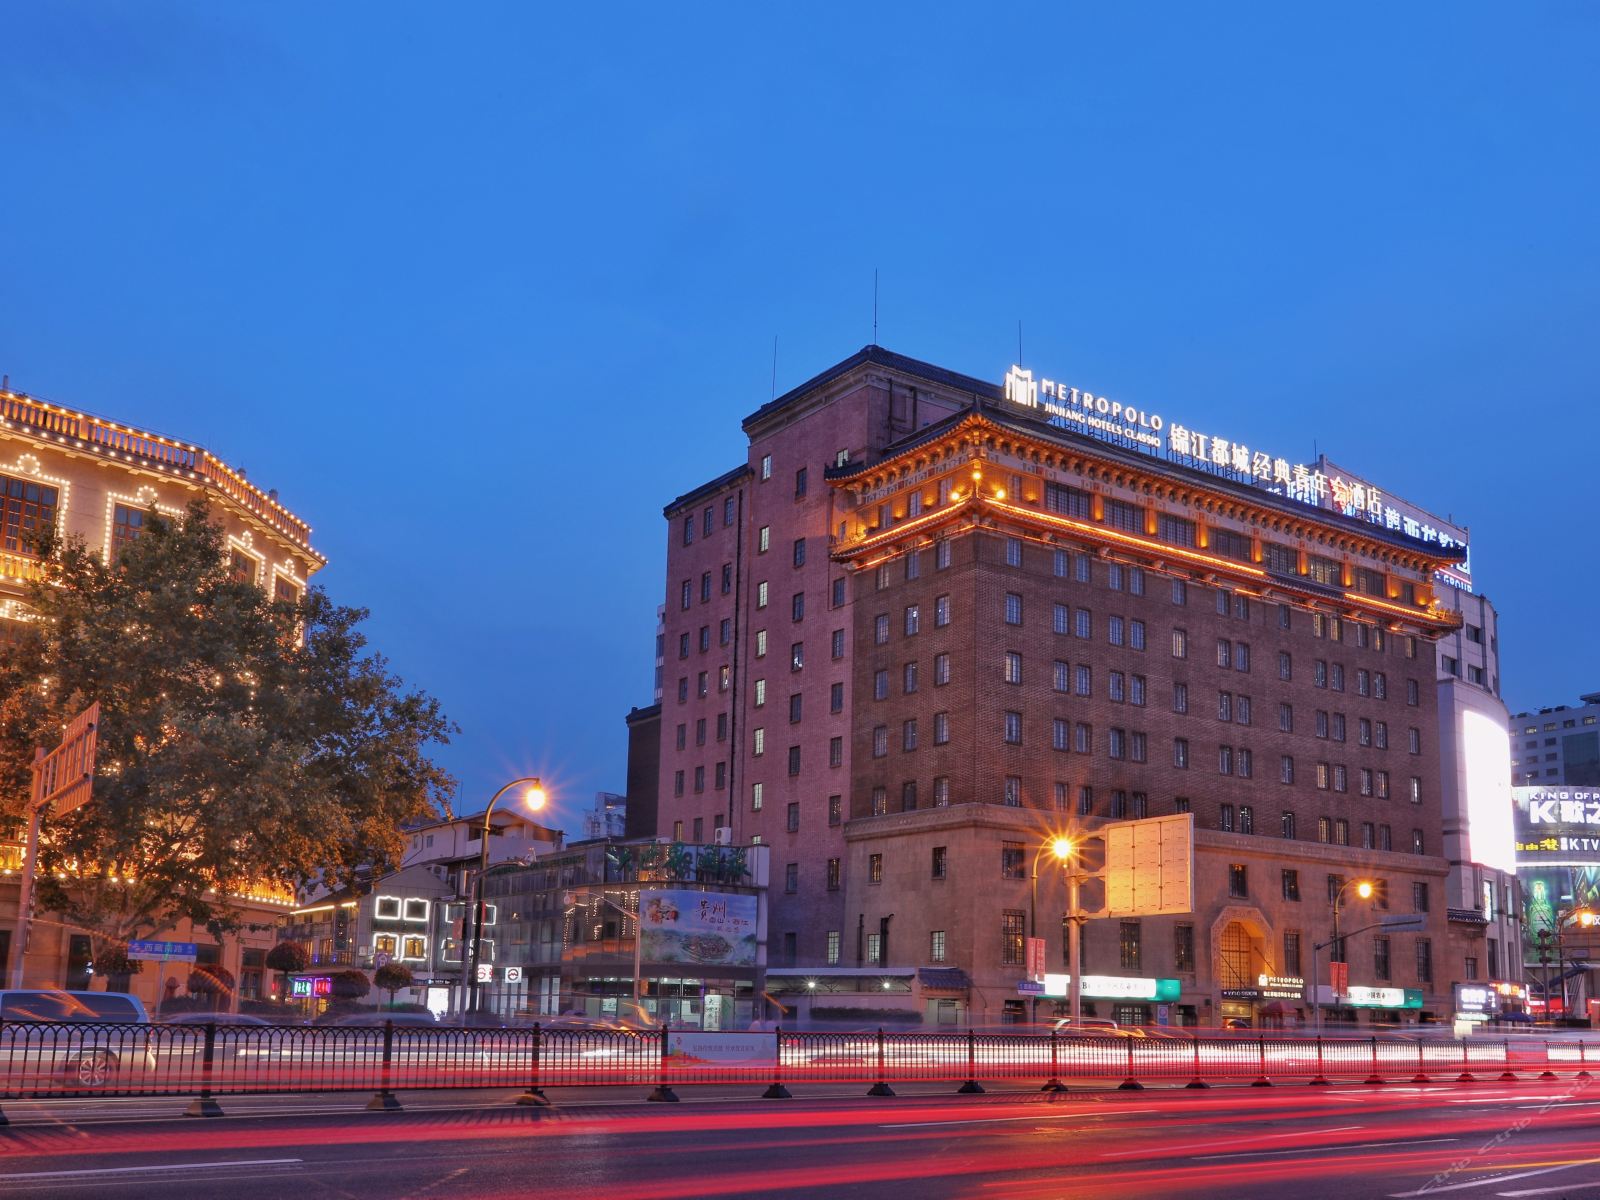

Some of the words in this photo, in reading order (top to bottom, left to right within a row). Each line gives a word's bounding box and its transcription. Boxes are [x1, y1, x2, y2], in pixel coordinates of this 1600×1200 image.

[1041, 378, 1163, 430] METROPOLO
[1044, 402, 1086, 424] JINJIANG
[1087, 415, 1123, 435] HOTELS
[1170, 423, 1382, 515] 锦江都城经典青年会酒店
[1529, 792, 1569, 800] KING
[1574, 792, 1590, 800] OF
[1569, 838, 1600, 851] KTV
[1268, 976, 1304, 984] METROPOLO
